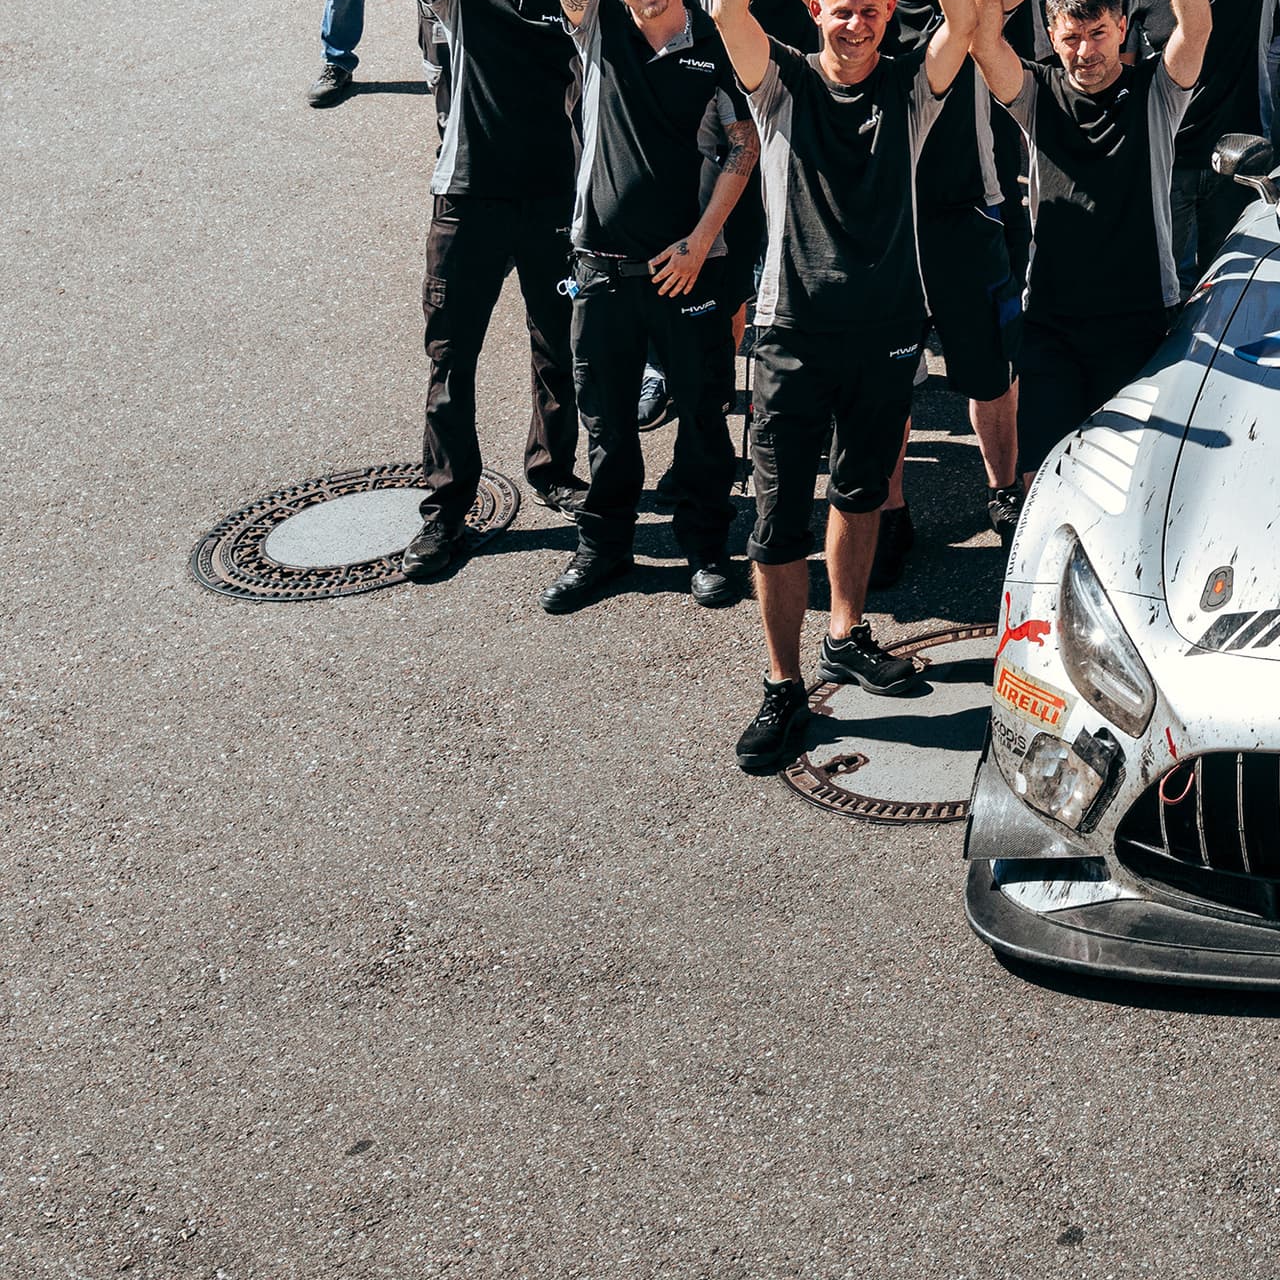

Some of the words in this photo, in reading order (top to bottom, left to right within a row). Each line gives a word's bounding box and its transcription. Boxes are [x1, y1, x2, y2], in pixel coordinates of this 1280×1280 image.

[541, 15, 564, 23] HW
[679, 57, 715, 70] HWA
[681, 299, 716, 314] HWA
[890, 343, 918, 357] HWA
[997, 668, 1067, 725] PIRELLI
